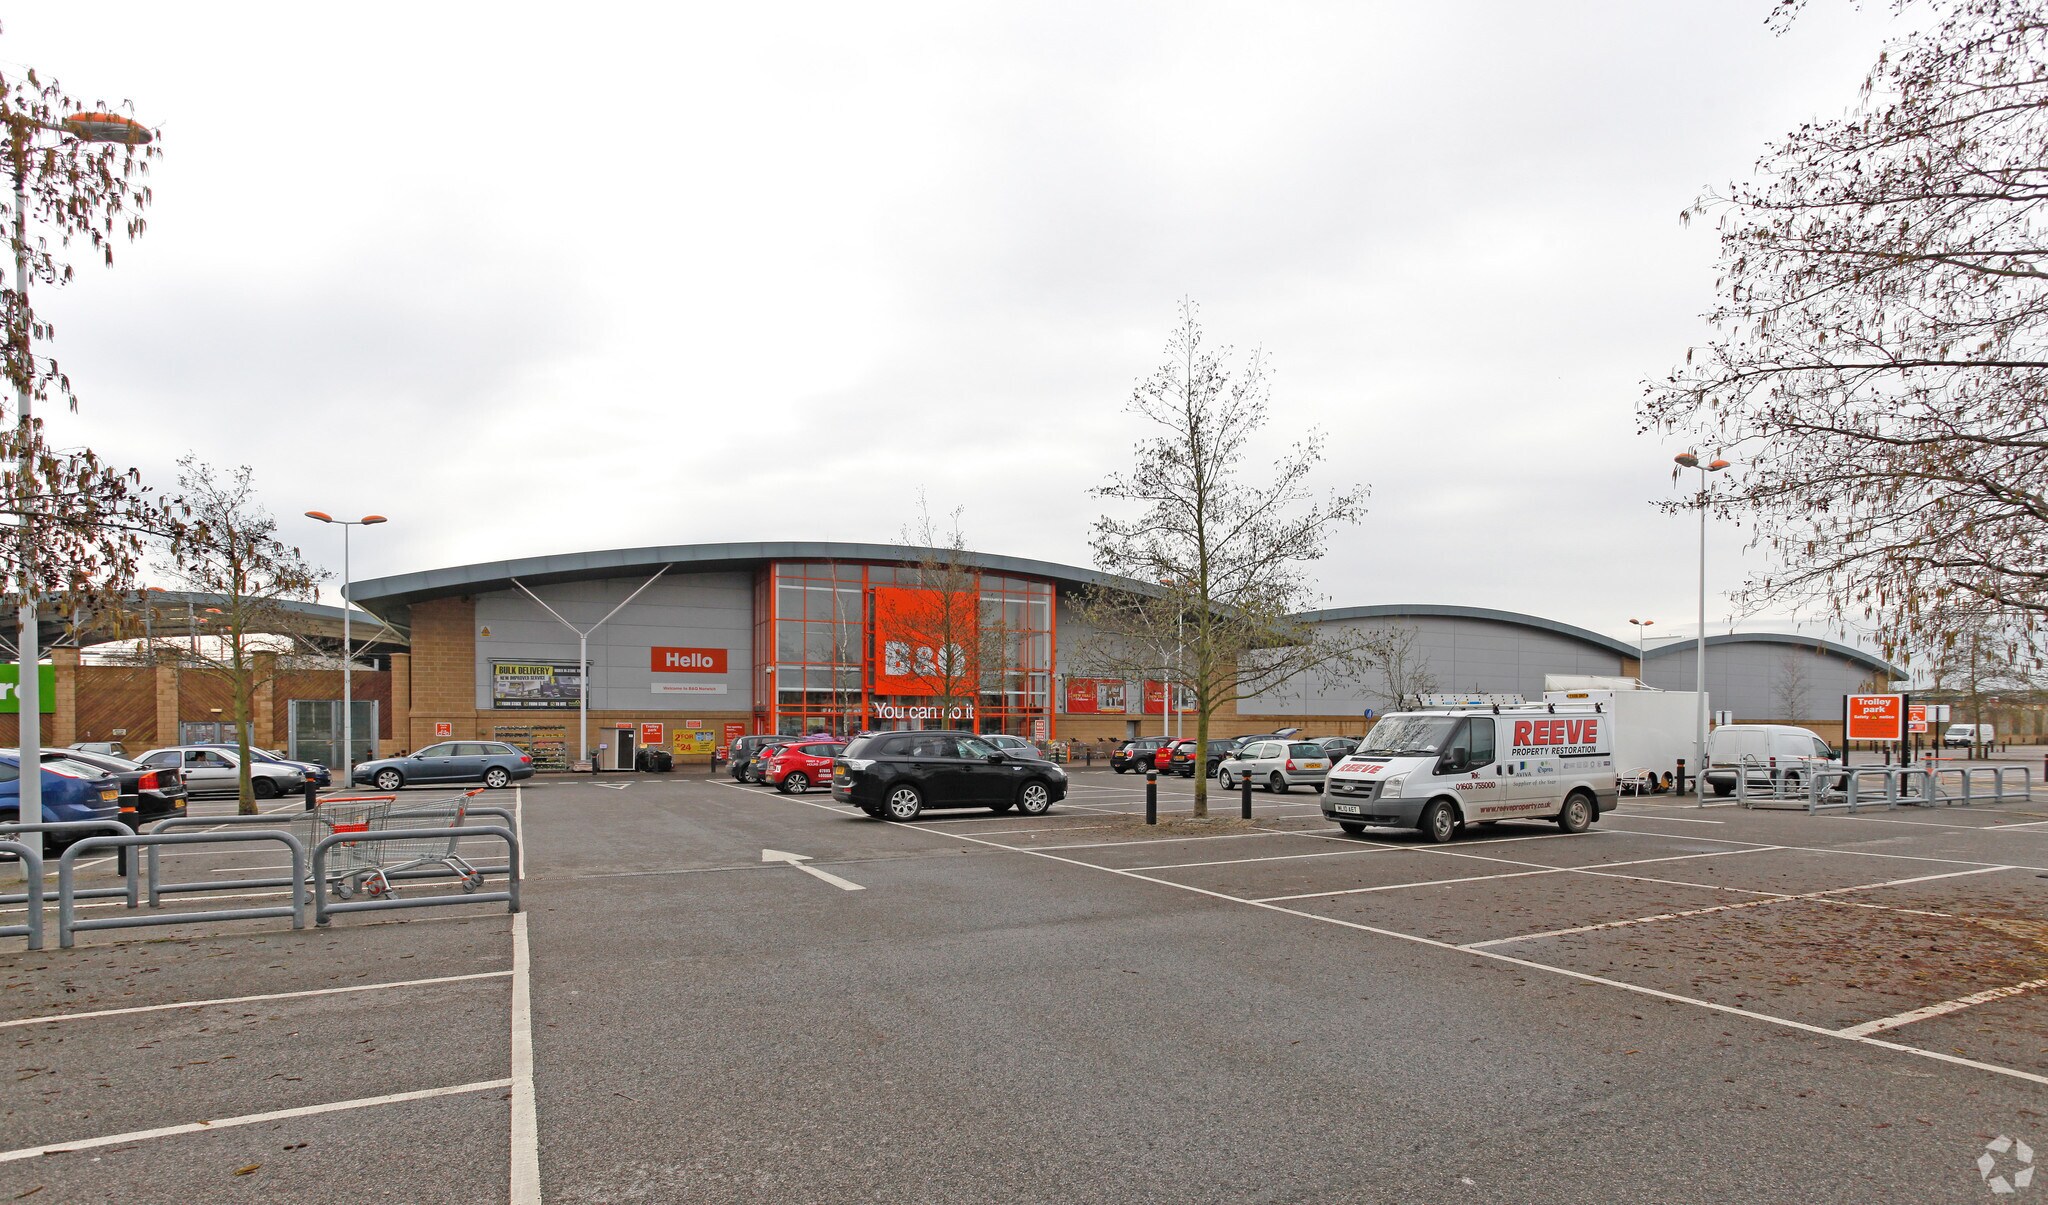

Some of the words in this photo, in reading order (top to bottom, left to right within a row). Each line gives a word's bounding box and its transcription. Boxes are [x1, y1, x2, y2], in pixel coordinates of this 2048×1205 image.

[665, 652, 714, 668] Hello
[499, 666, 516, 674] BULK
[518, 666, 550, 675] DELIVERY
[1858, 698, 1891, 706] Trolley
[874, 702, 904, 719] You
[909, 706, 937, 719] can
[966, 703, 974, 719] it
[1863, 706, 1885, 714] park
[1513, 719, 1598, 747] REEVE
[1511, 747, 1549, 756] PROPERTY
[1551, 746, 1597, 755] RESTORATION
[1338, 763, 1385, 774] REEVE
[1455, 783, 1473, 791] 01603
[1474, 781, 1496, 790] 755000
[1513, 779, 1531, 787] Supplier
[1479, 801, 1551, 814] www.reeveproperty.co.uk
